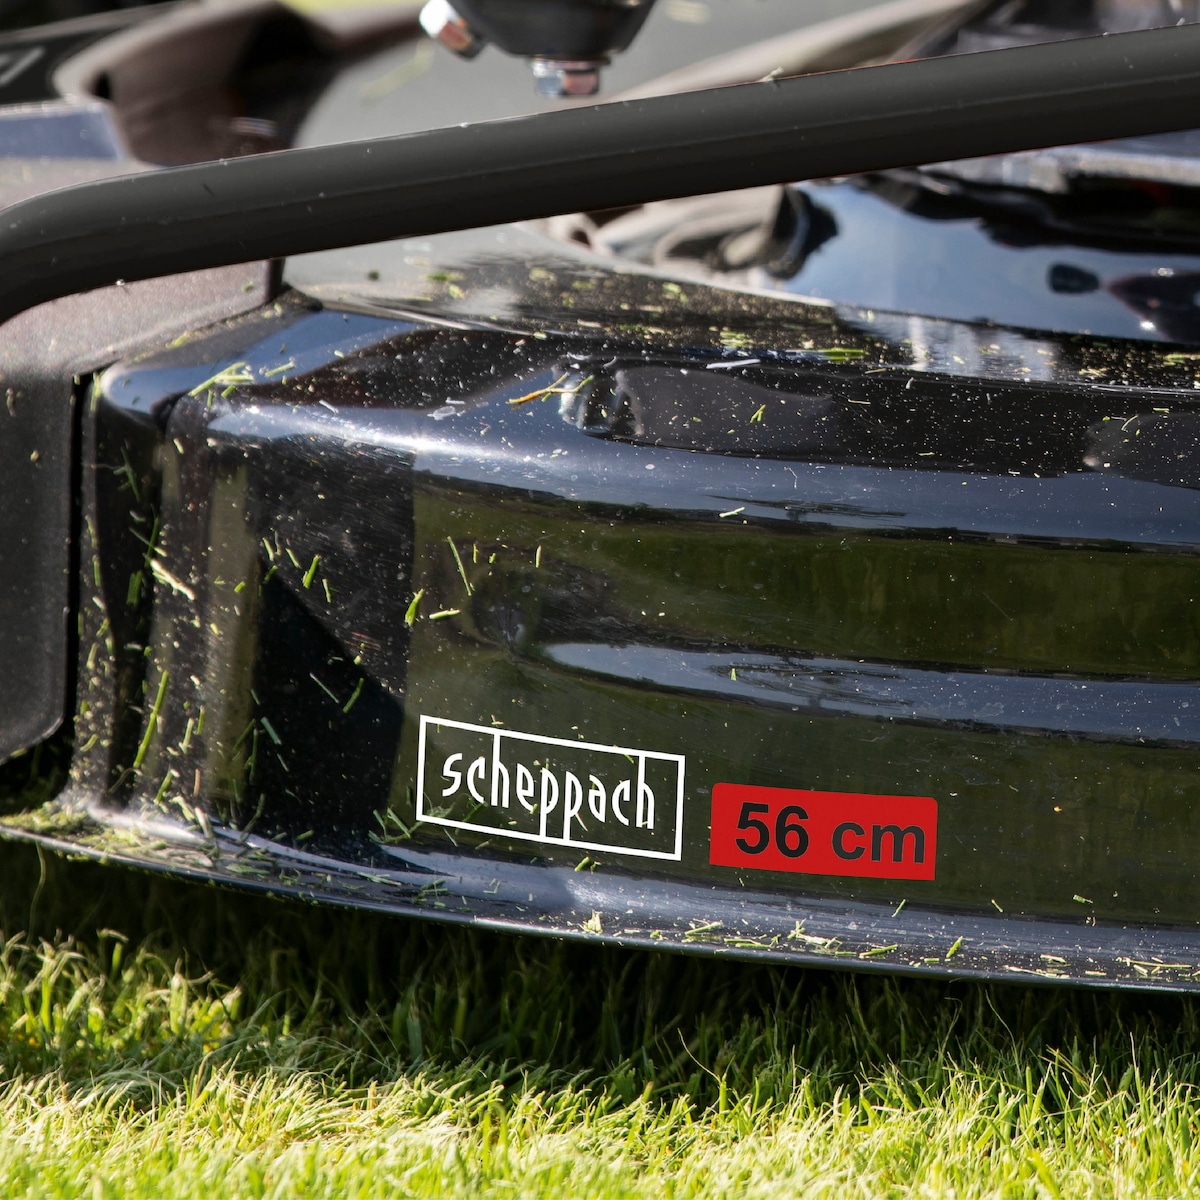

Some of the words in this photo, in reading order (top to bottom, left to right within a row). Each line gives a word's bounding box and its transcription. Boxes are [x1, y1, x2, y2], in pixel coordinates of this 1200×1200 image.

[441, 730, 656, 842] scheppach
[734, 802, 810, 858] 56
[831, 820, 926, 864] cm
